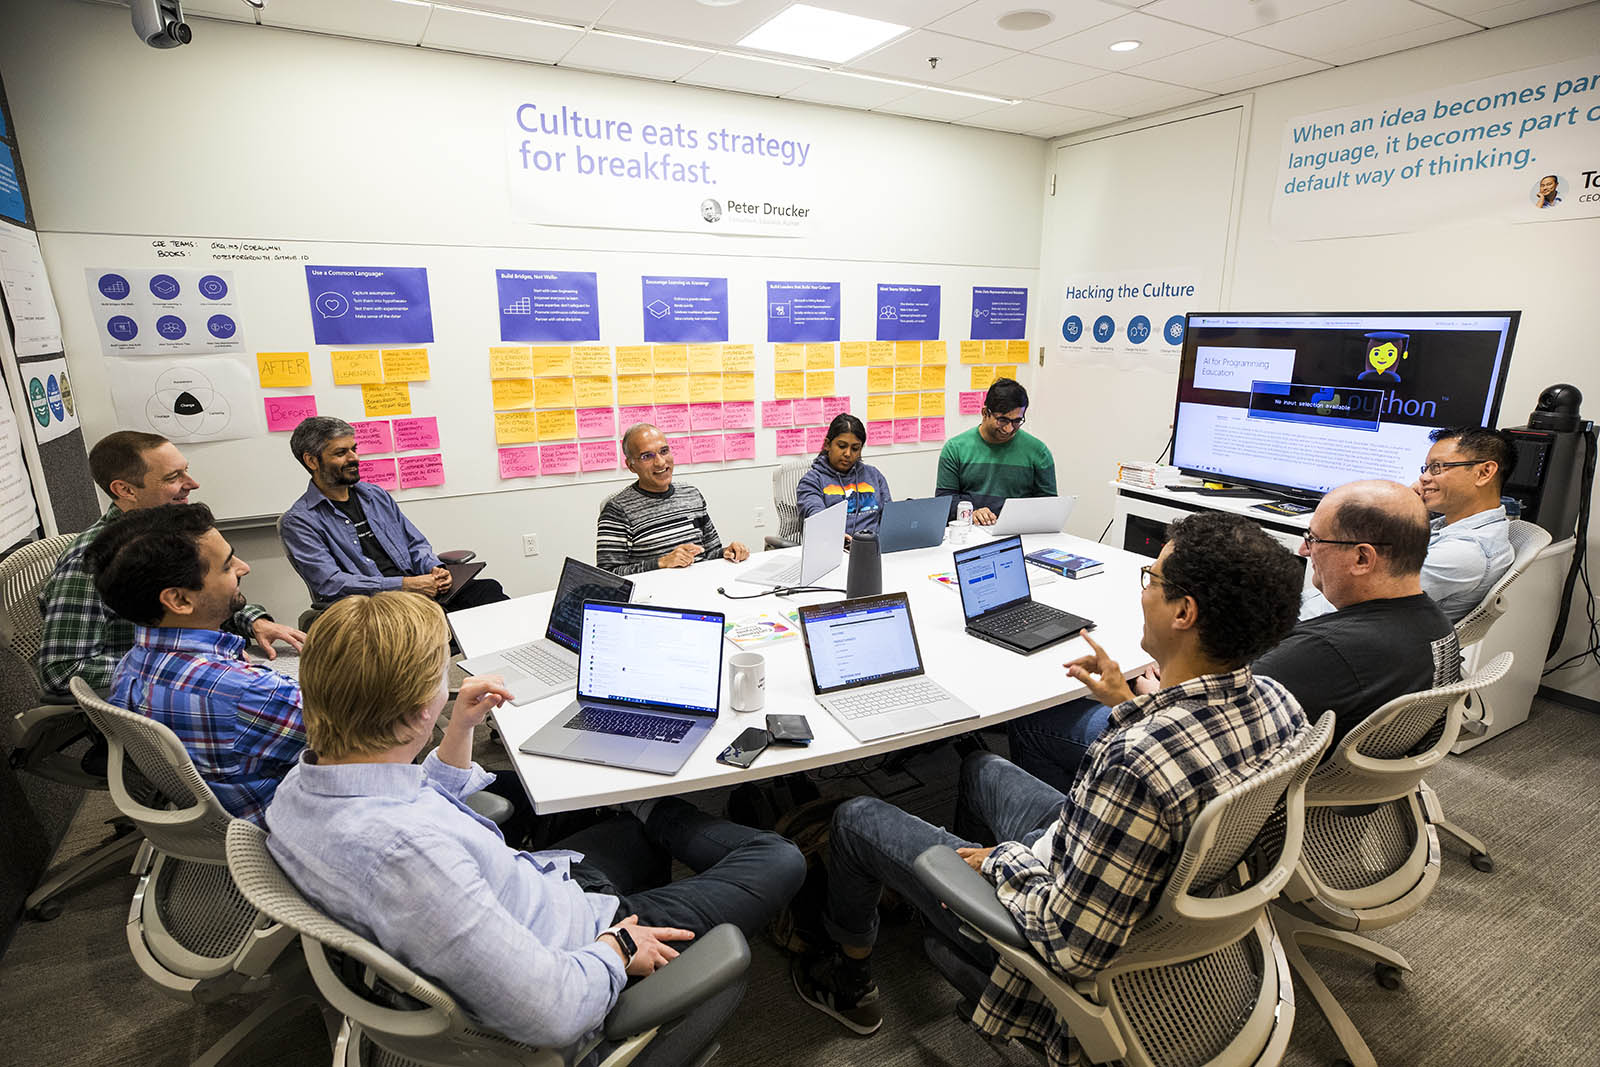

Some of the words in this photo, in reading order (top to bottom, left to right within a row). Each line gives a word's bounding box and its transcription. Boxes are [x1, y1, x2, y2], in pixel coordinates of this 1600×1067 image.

[1293, 123, 1345, 145] When
[1350, 115, 1373, 134] an
[1380, 106, 1426, 129] idea
[1433, 84, 1546, 119] becomes
[516, 103, 633, 142] Culture
[641, 122, 698, 150] eats
[707, 128, 811, 167] strategy
[1287, 143, 1379, 170] language,
[1385, 136, 1401, 155] it
[1405, 119, 1512, 151] becomes
[1518, 105, 1579, 139] part
[519, 140, 566, 173] for
[576, 145, 718, 186] breakfast.
[1284, 169, 1350, 195] default
[1355, 165, 1395, 188] way
[1401, 159, 1424, 180] of
[1428, 147, 1537, 177] thinking.
[727, 200, 760, 214] Peter
[763, 202, 810, 217] Drucker
[1066, 284, 1114, 302] Hacking
[1118, 283, 1139, 298] the
[1142, 282, 1195, 298] Culture
[261, 358, 307, 376] AFTER
[1201, 368, 1234, 377] Education
[1212, 358, 1221, 366] for
[1222, 358, 1270, 370] Programming
[1298, 400, 1324, 409] selection
[1325, 401, 1350, 411] available
[1348, 388, 1436, 418] python
